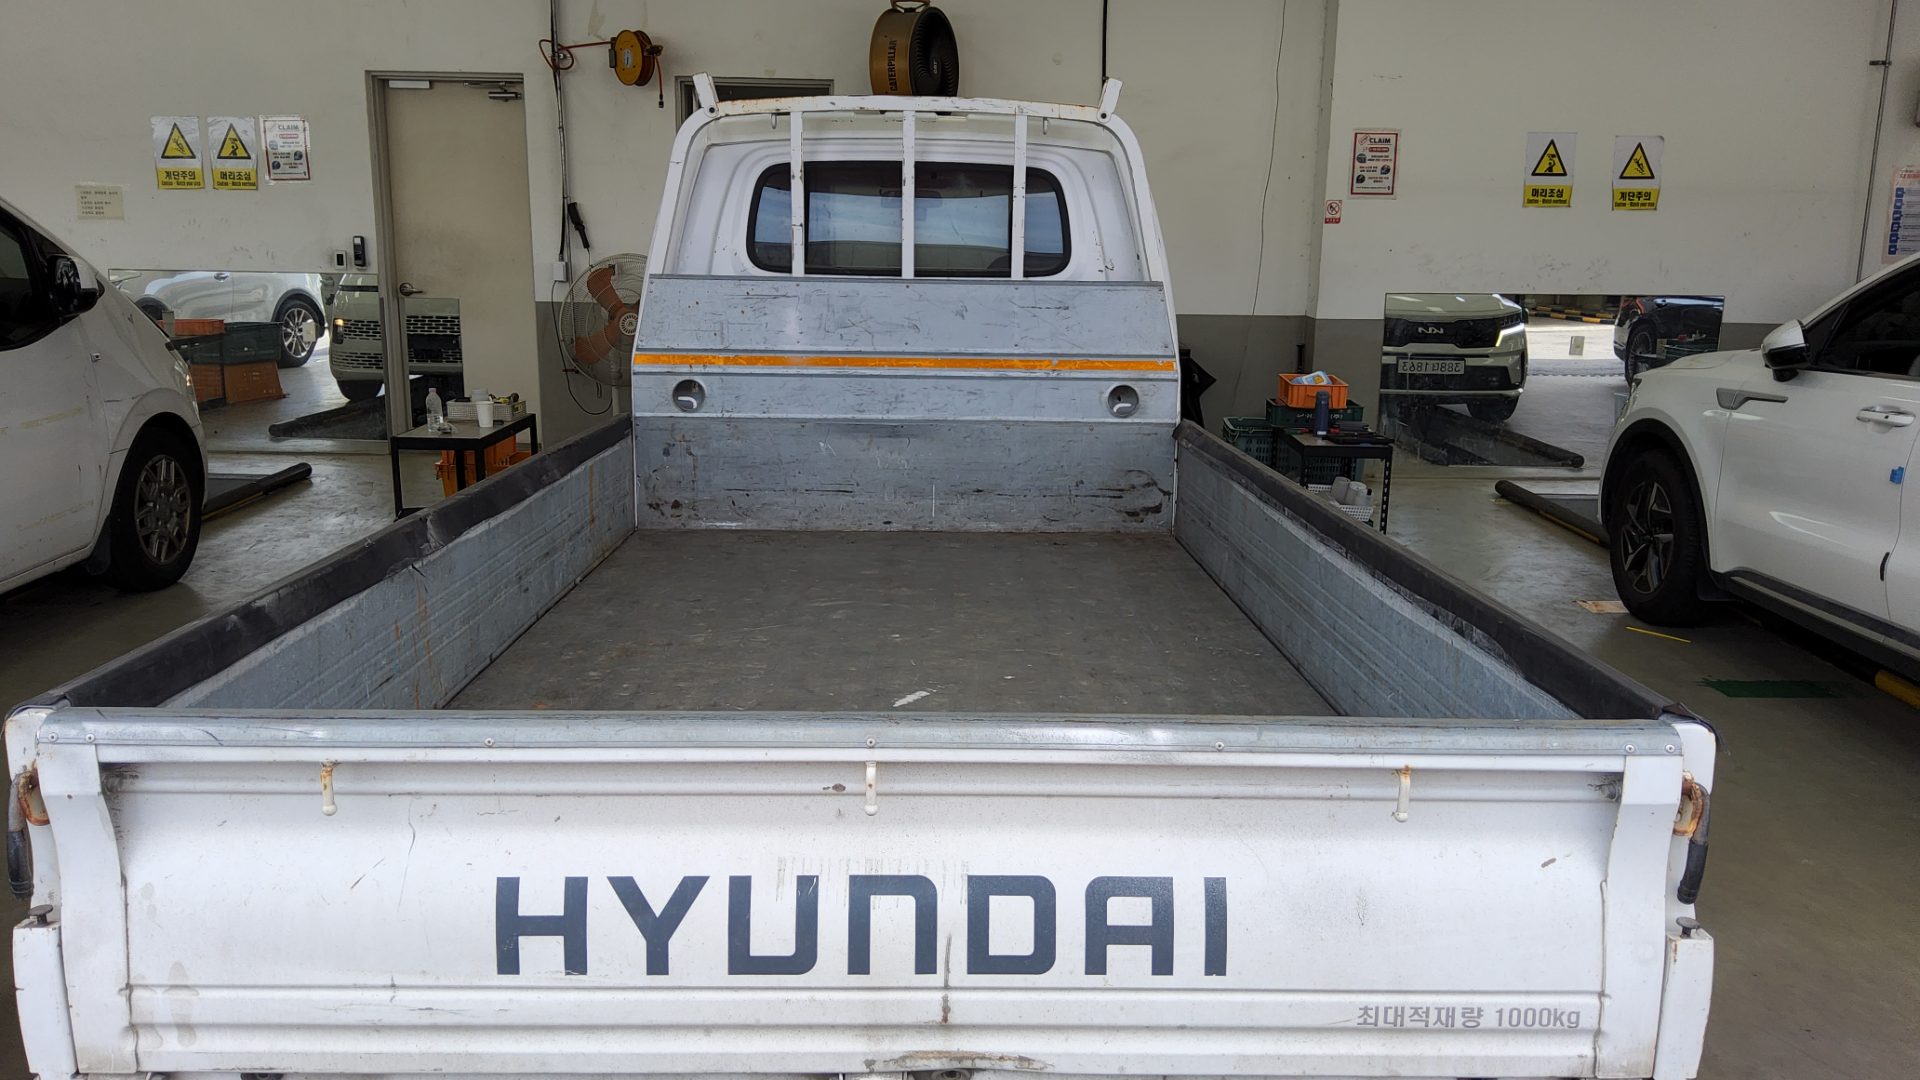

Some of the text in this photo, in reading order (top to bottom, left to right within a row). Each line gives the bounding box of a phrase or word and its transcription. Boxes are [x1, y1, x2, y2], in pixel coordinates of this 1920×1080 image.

[888, 40, 898, 91] CATERPILLAR
[164, 170, 196, 180] 계단주의
[220, 171, 251, 181] 머리조심
[1531, 188, 1564, 198] 머리조심
[1619, 191, 1652, 201] 계단주의
[496, 875, 1227, 976] HYUNDAI
[1356, 1005, 1582, 1029] 최대적재량 1000kg
